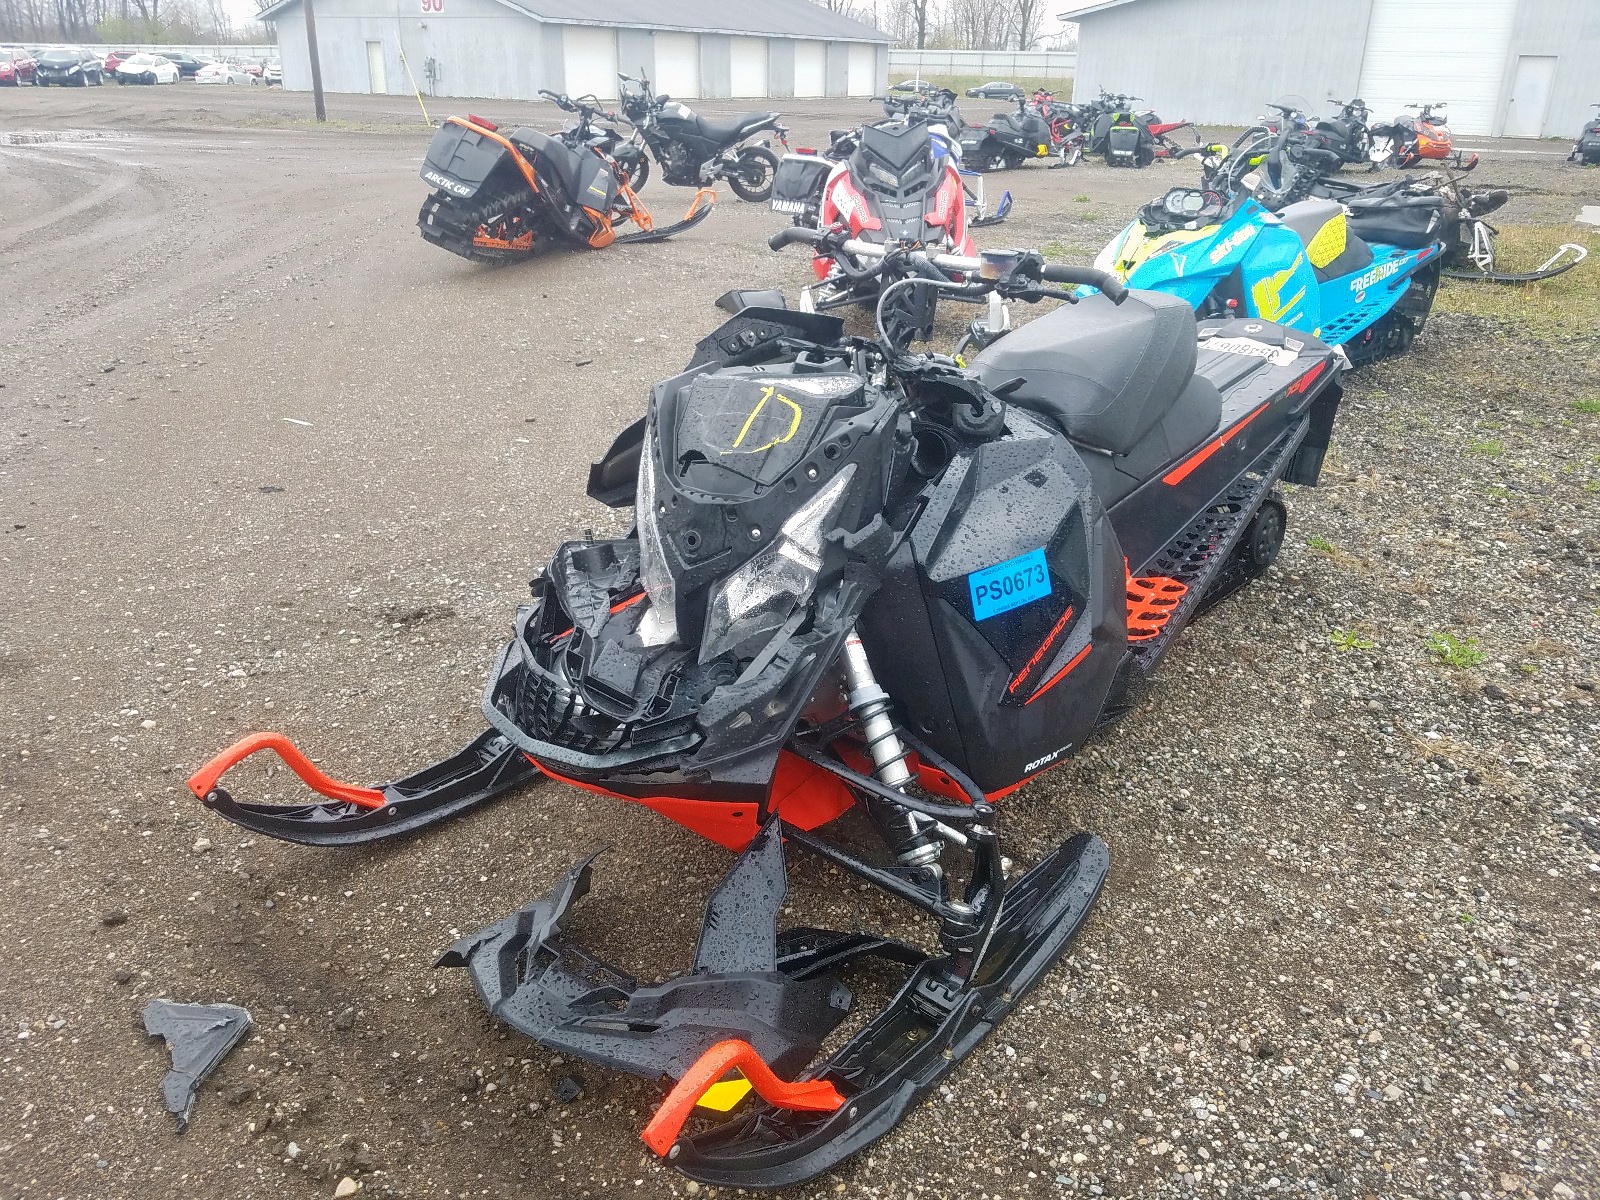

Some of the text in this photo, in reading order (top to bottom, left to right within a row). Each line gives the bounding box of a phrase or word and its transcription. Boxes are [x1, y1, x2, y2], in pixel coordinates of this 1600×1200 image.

[421, 0, 443, 12] 90
[424, 171, 471, 196] ARCTIC CAT
[772, 199, 805, 214] YAMAHA
[1350, 259, 1399, 294] FREERIDE
[975, 563, 1045, 606] PS0673
[1009, 604, 1073, 693] RENEGADE
[1024, 750, 1060, 773] ROTAX
